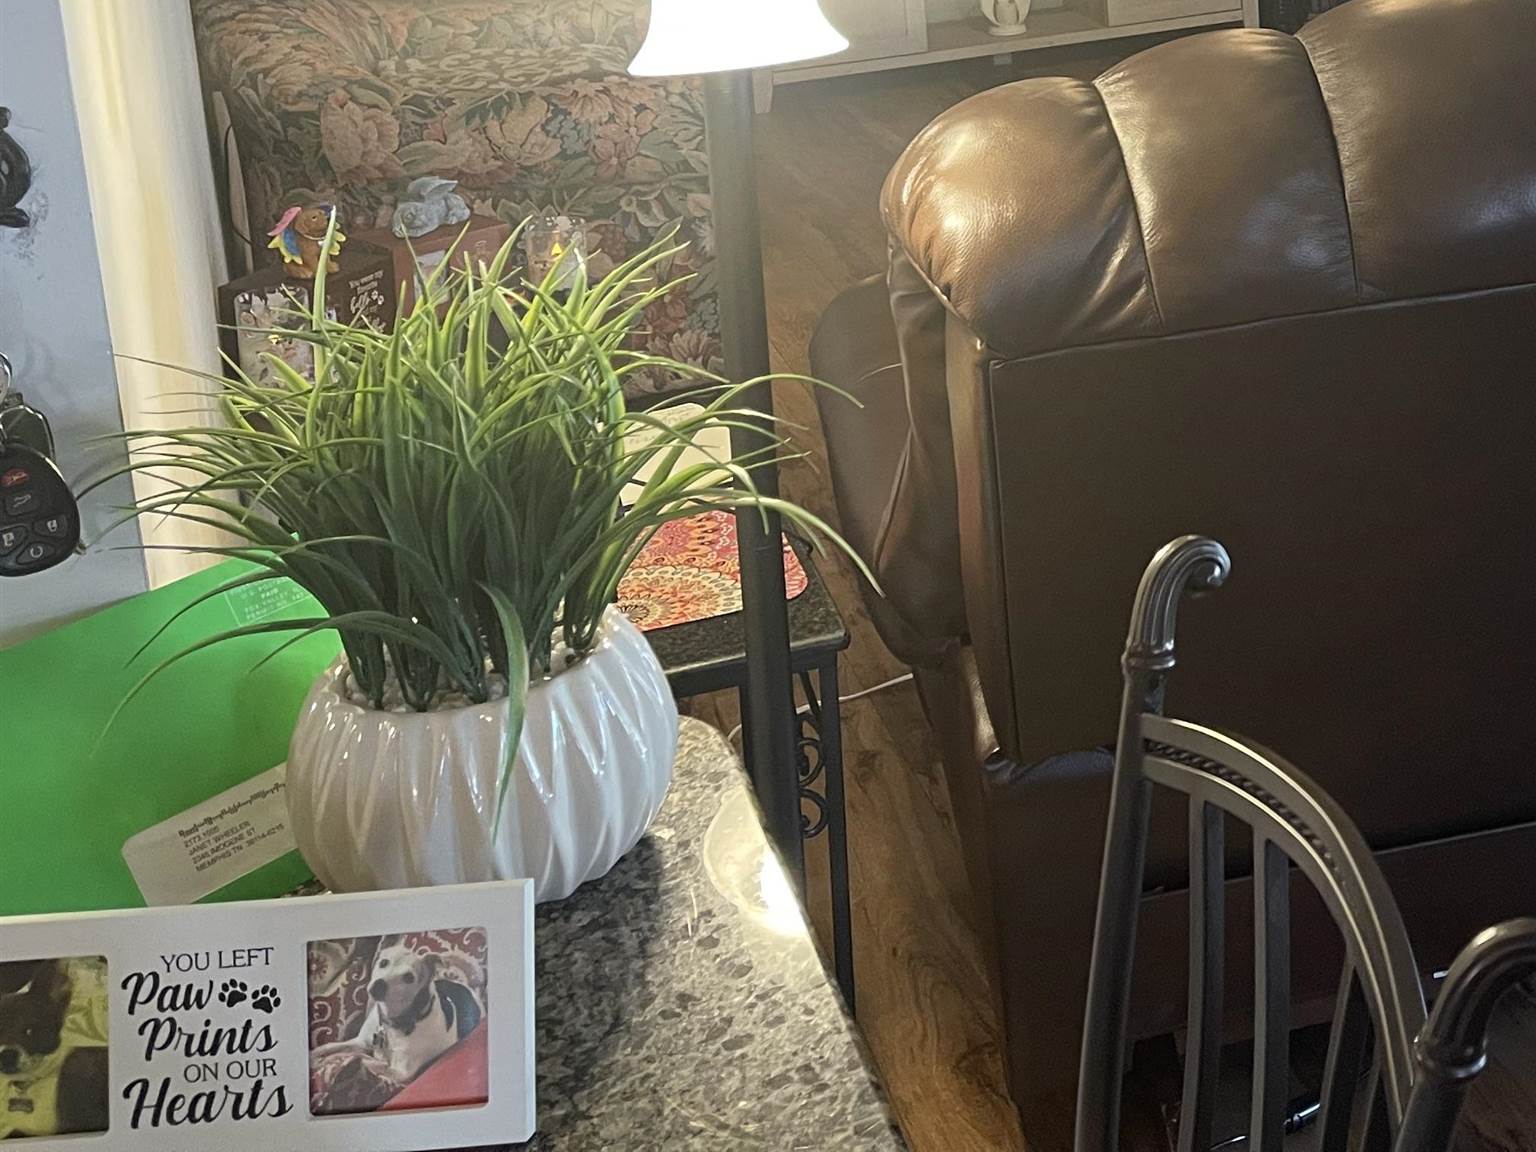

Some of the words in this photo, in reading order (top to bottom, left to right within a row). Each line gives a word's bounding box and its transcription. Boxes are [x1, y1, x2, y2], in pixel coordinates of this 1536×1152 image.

[160, 952, 211, 973] YOU
[217, 947, 275, 969] LEFT
[120, 970, 214, 1016] Paw
[138, 1017, 279, 1061] Prints
[183, 1063, 221, 1084] ON
[226, 1058, 278, 1080] OUR
[122, 1077, 294, 1130] Hearts
